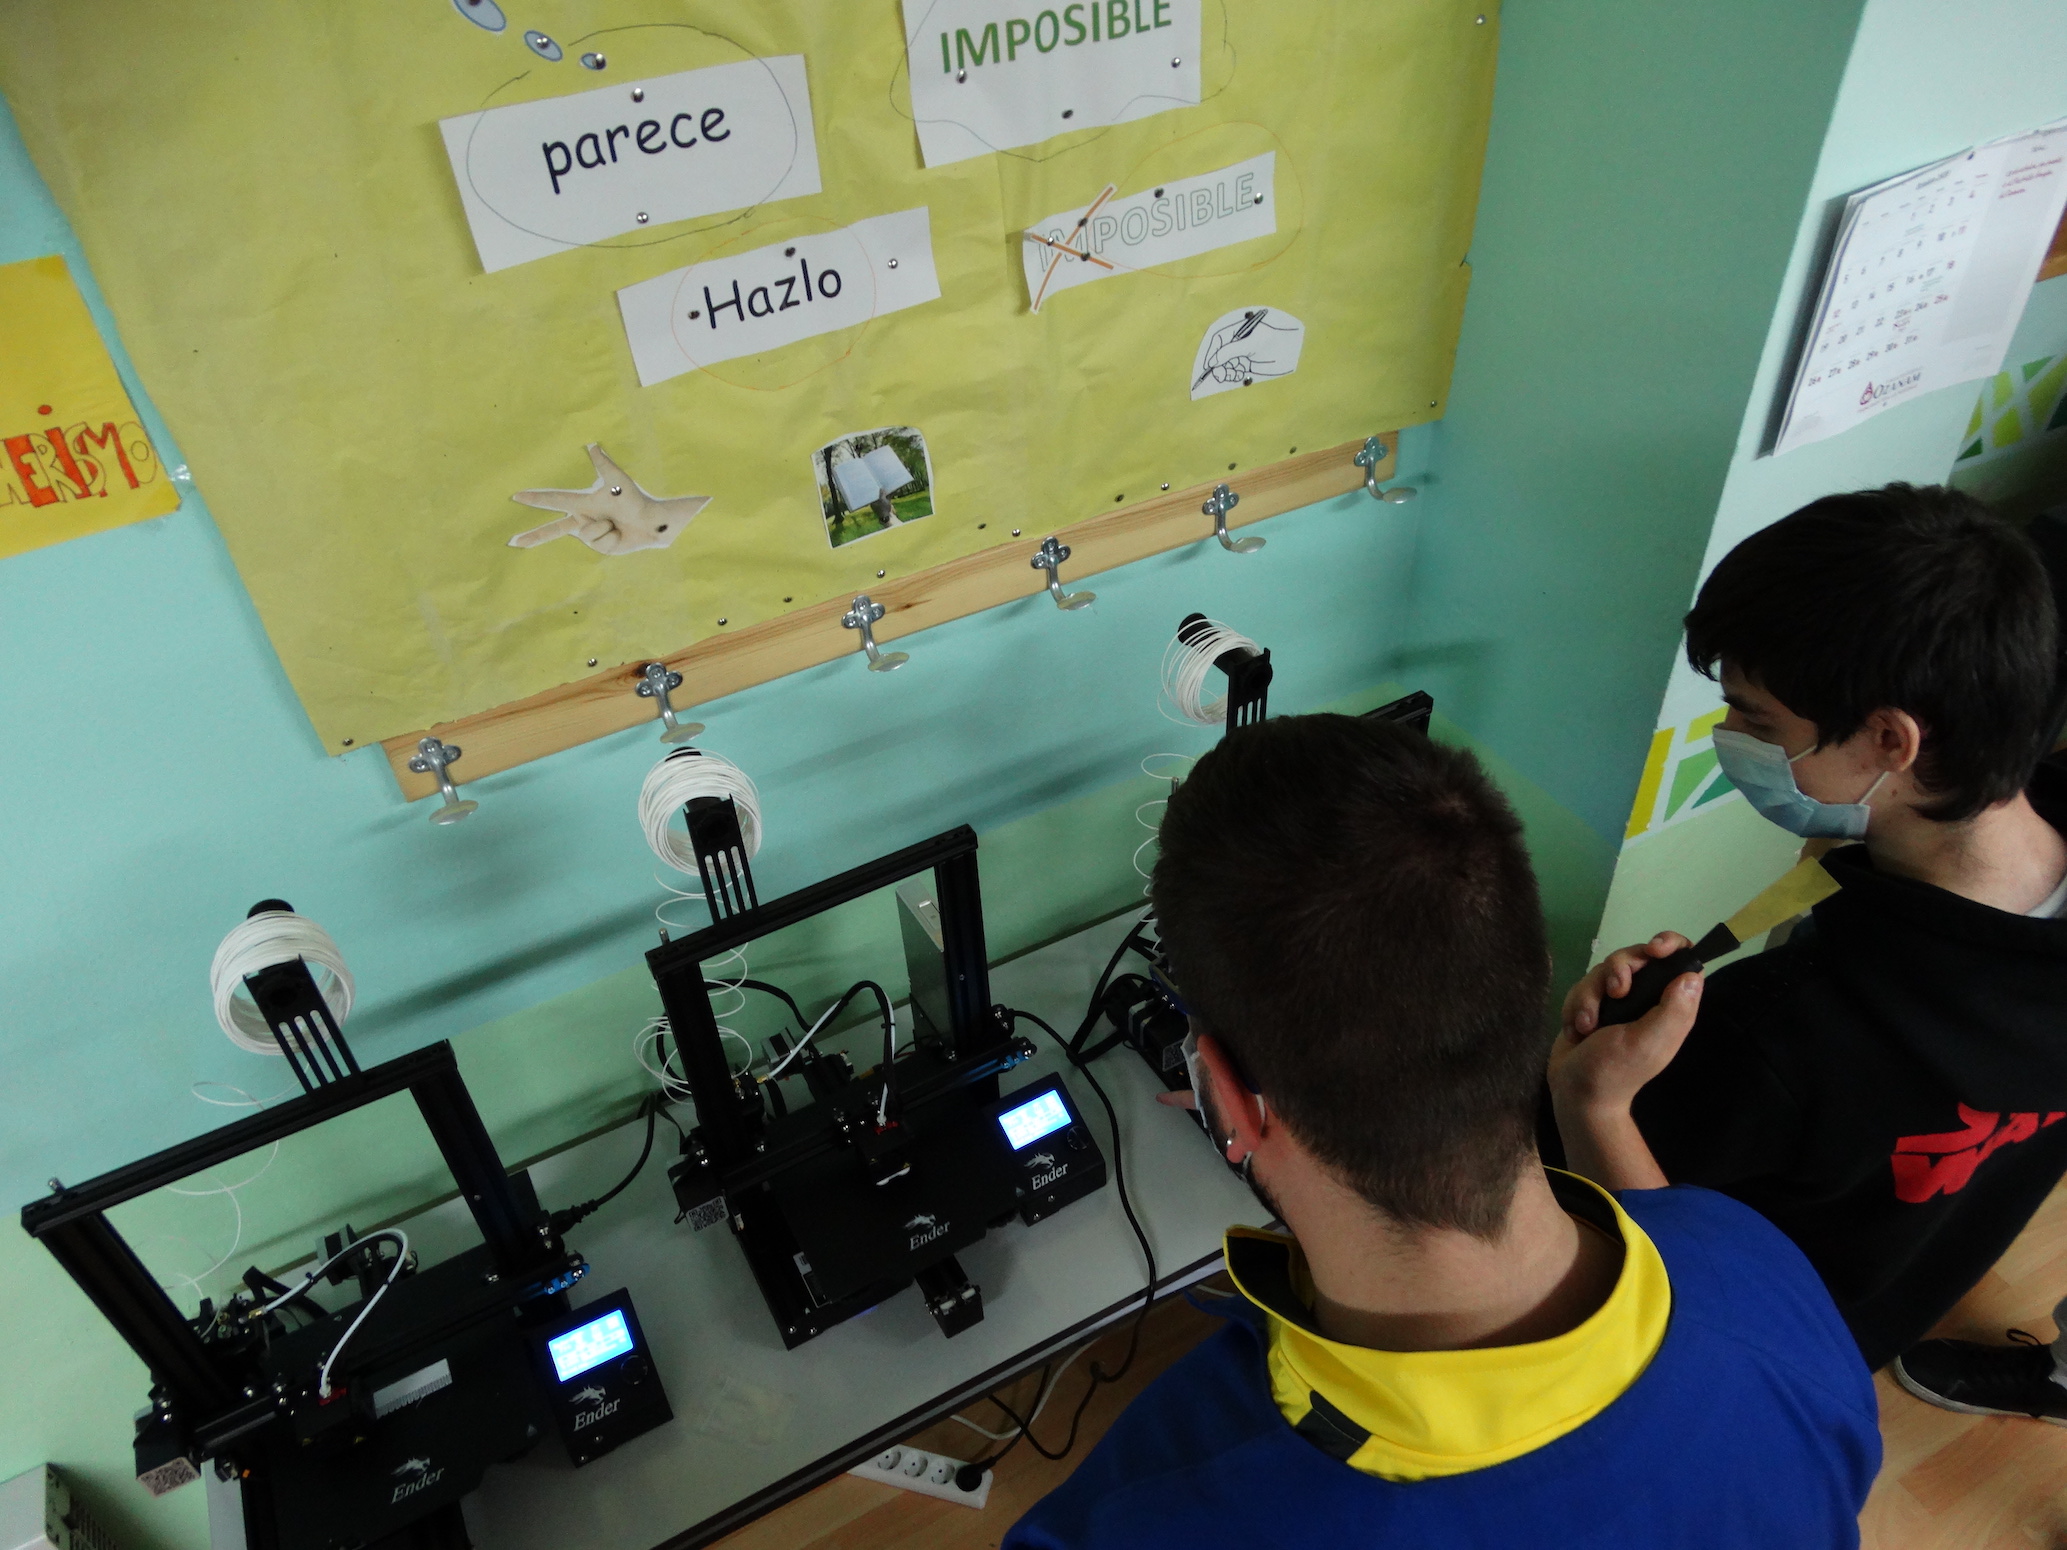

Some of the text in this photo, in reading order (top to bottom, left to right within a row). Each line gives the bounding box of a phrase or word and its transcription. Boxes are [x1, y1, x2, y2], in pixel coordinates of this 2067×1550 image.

[940, 0, 1172, 74] IMPOSIBLE
[541, 107, 731, 195] parece
[703, 257, 842, 330] Hazlo
[1031, 1163, 1068, 1191] Ender
[909, 1221, 951, 1252] Ender
[573, 1398, 621, 1432] Ender
[390, 1467, 445, 1505] Ender
